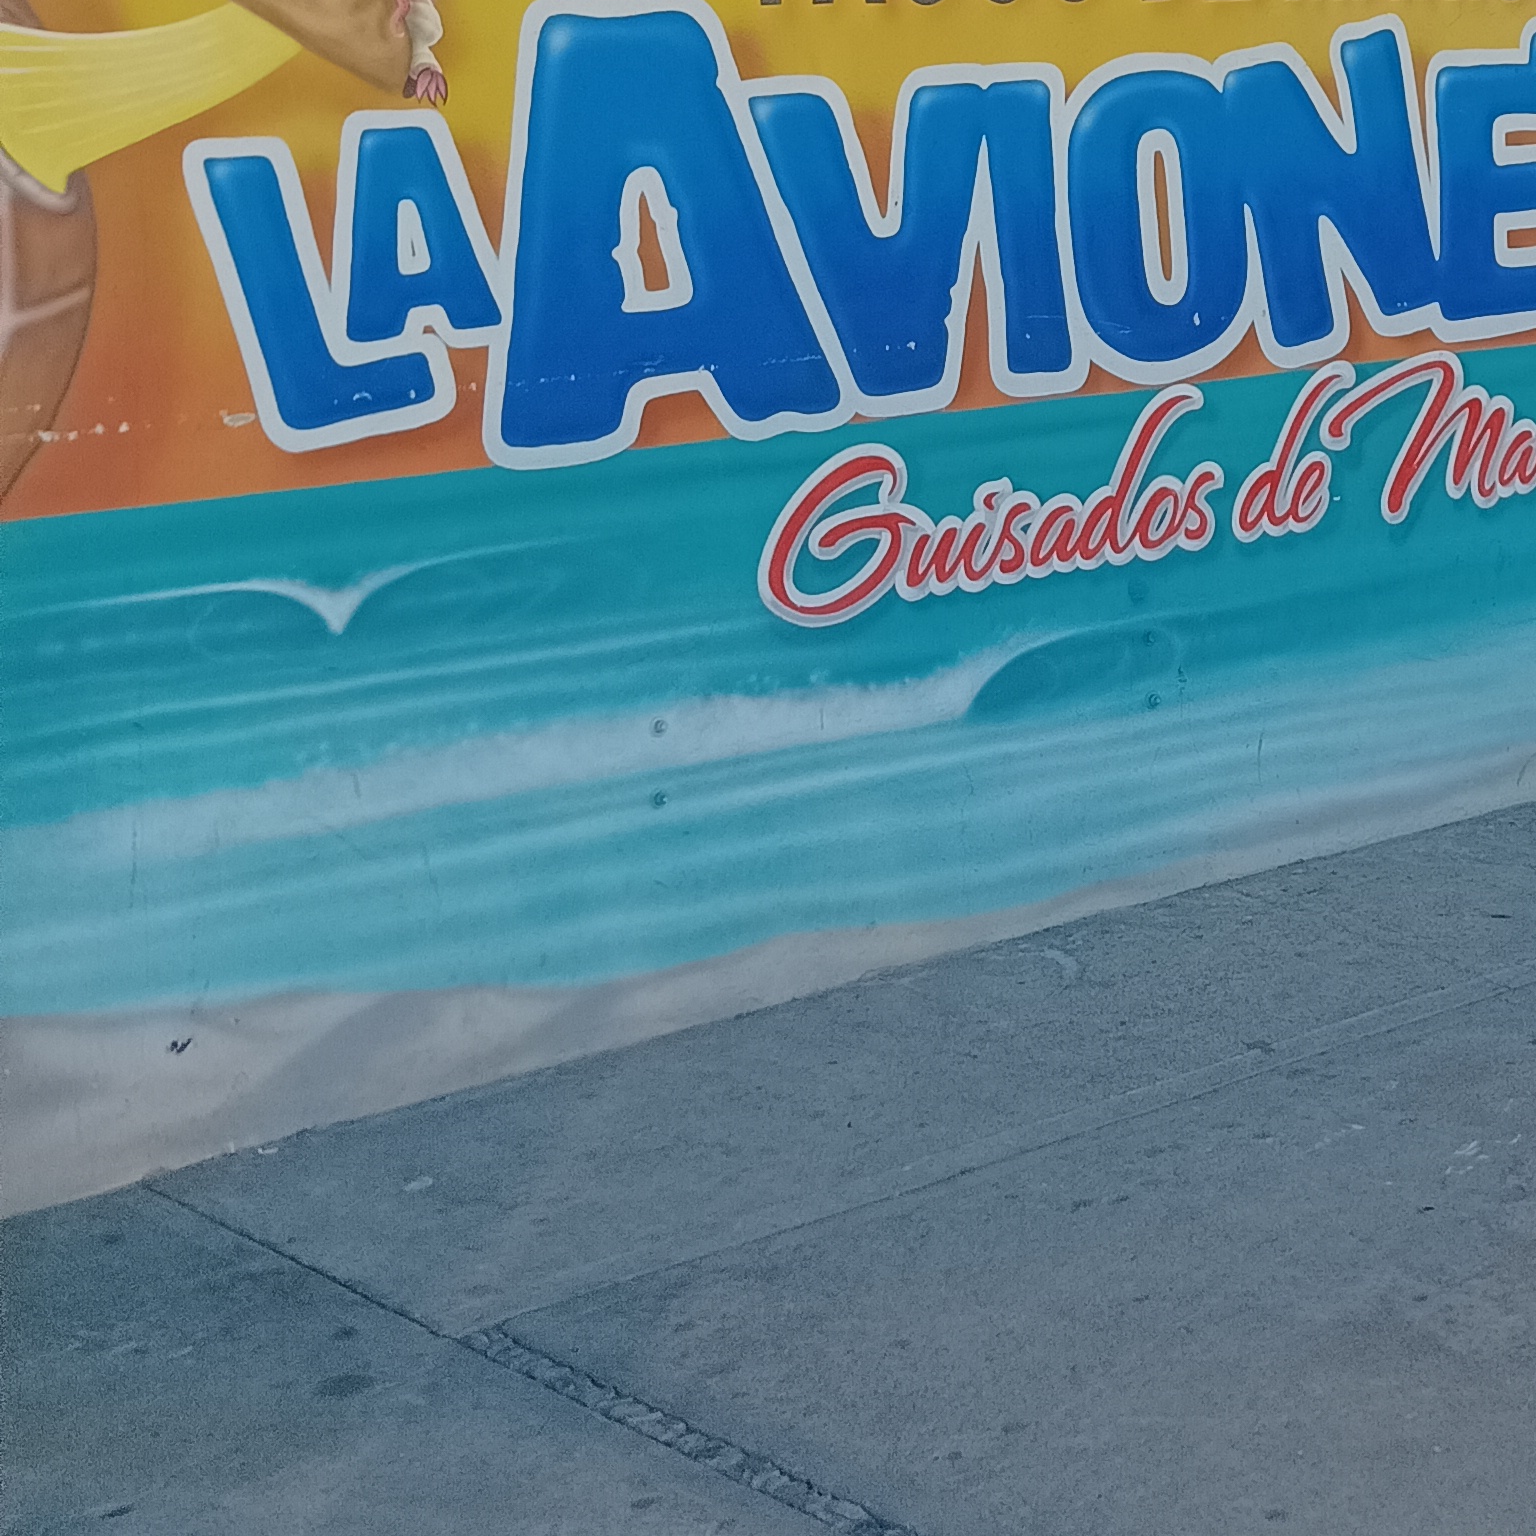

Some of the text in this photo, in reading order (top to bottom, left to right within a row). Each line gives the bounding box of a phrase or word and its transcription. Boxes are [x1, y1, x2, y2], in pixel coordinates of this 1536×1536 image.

[183, 109, 505, 451] LA
[758, 383, 1225, 628] Guisados
[1232, 361, 1356, 542] de
